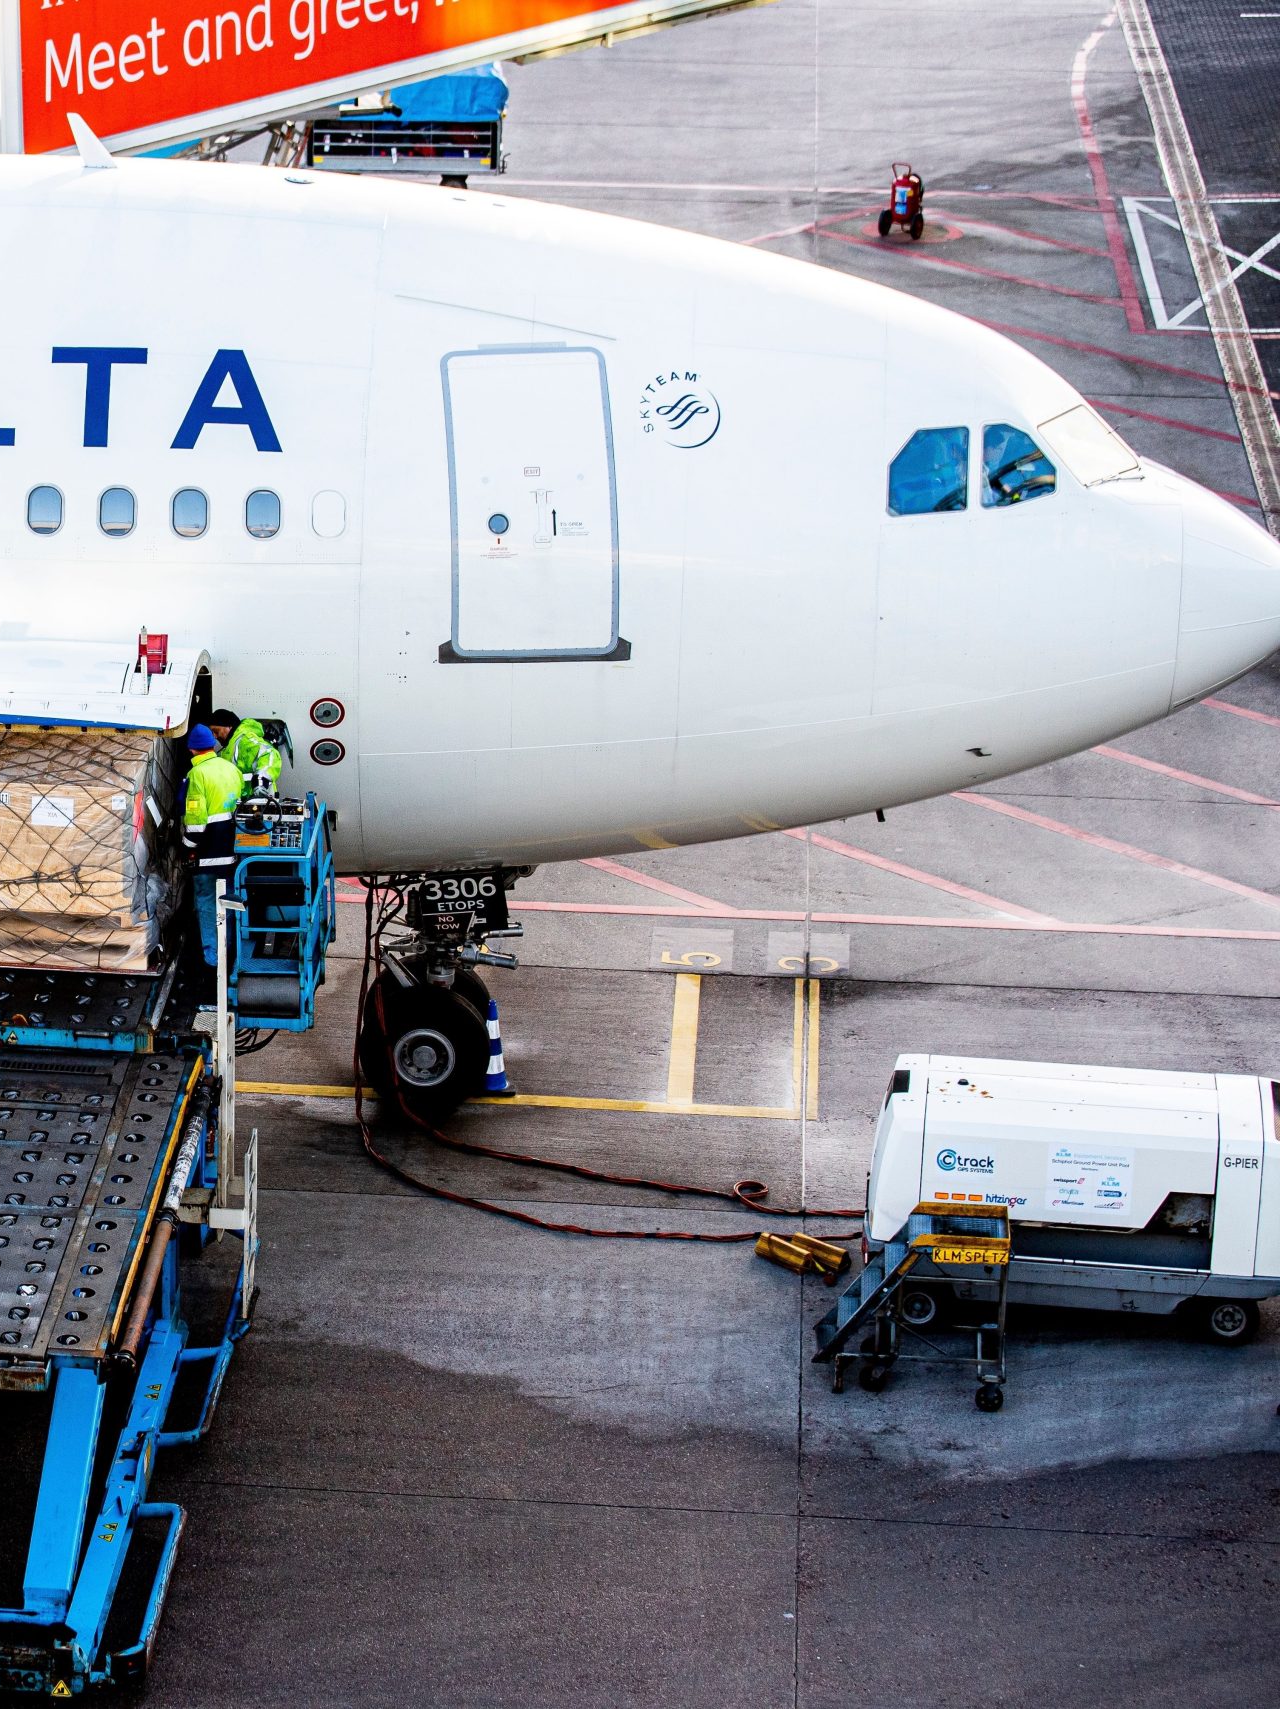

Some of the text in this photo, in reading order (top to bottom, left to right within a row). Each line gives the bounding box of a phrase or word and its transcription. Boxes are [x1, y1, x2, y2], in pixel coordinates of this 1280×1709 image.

[45, 17, 168, 103] Meet
[183, 0, 273, 67] and
[640, 371, 697, 433] SKYTEAM
[424, 876, 497, 900] 3306
[437, 900, 485, 912] ETOPS
[438, 915, 455, 923] NO
[434, 923, 460, 931] TOW
[1224, 1157, 1259, 1169] G-PIER
[985, 1194, 1027, 1208] hitzinger
[934, 1249, 961, 1261] KLM
[964, 1252, 989, 1263] SPL
